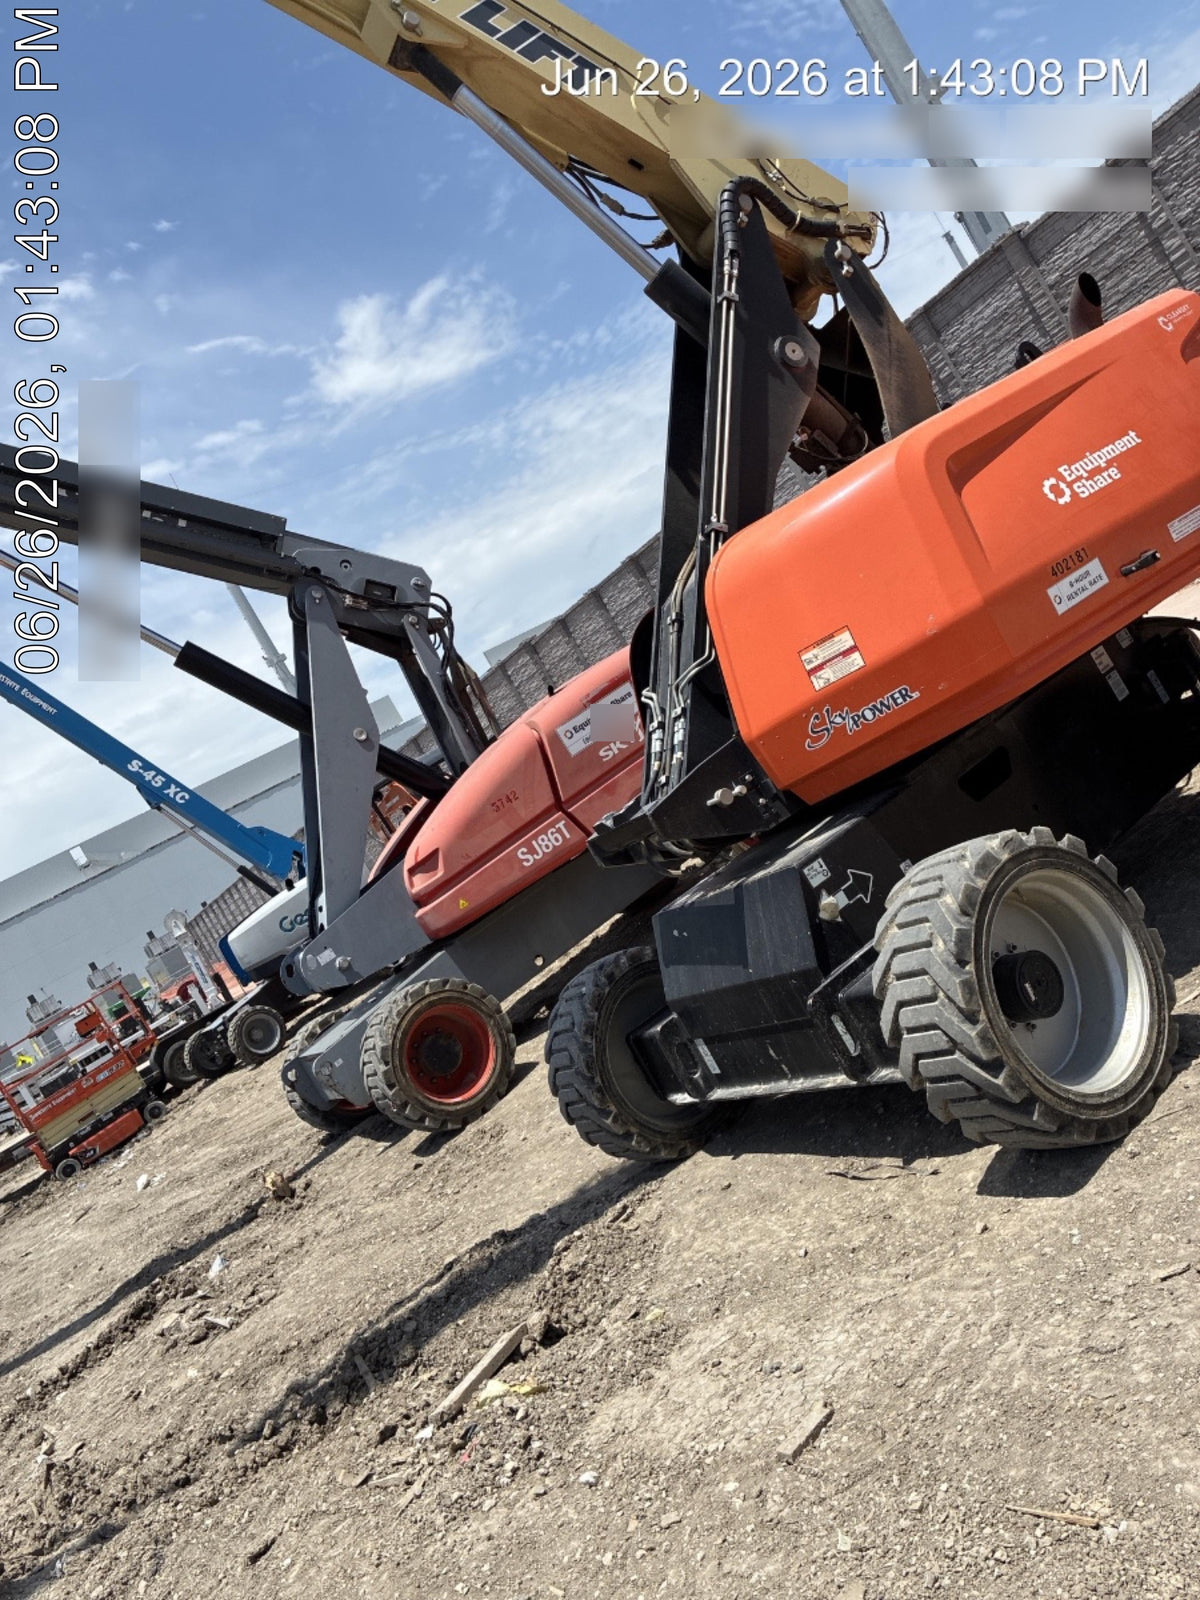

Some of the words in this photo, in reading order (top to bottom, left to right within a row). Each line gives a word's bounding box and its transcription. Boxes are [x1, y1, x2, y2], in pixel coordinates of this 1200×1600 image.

[457, 0, 612, 93] LIFT
[1057, 429, 1142, 482] Equipment
[1073, 465, 1122, 499] Share
[1051, 547, 1089, 577] 402181
[127, 759, 167, 788] S-45
[163, 783, 190, 804] XC
[516, 820, 571, 867] SJ86T
